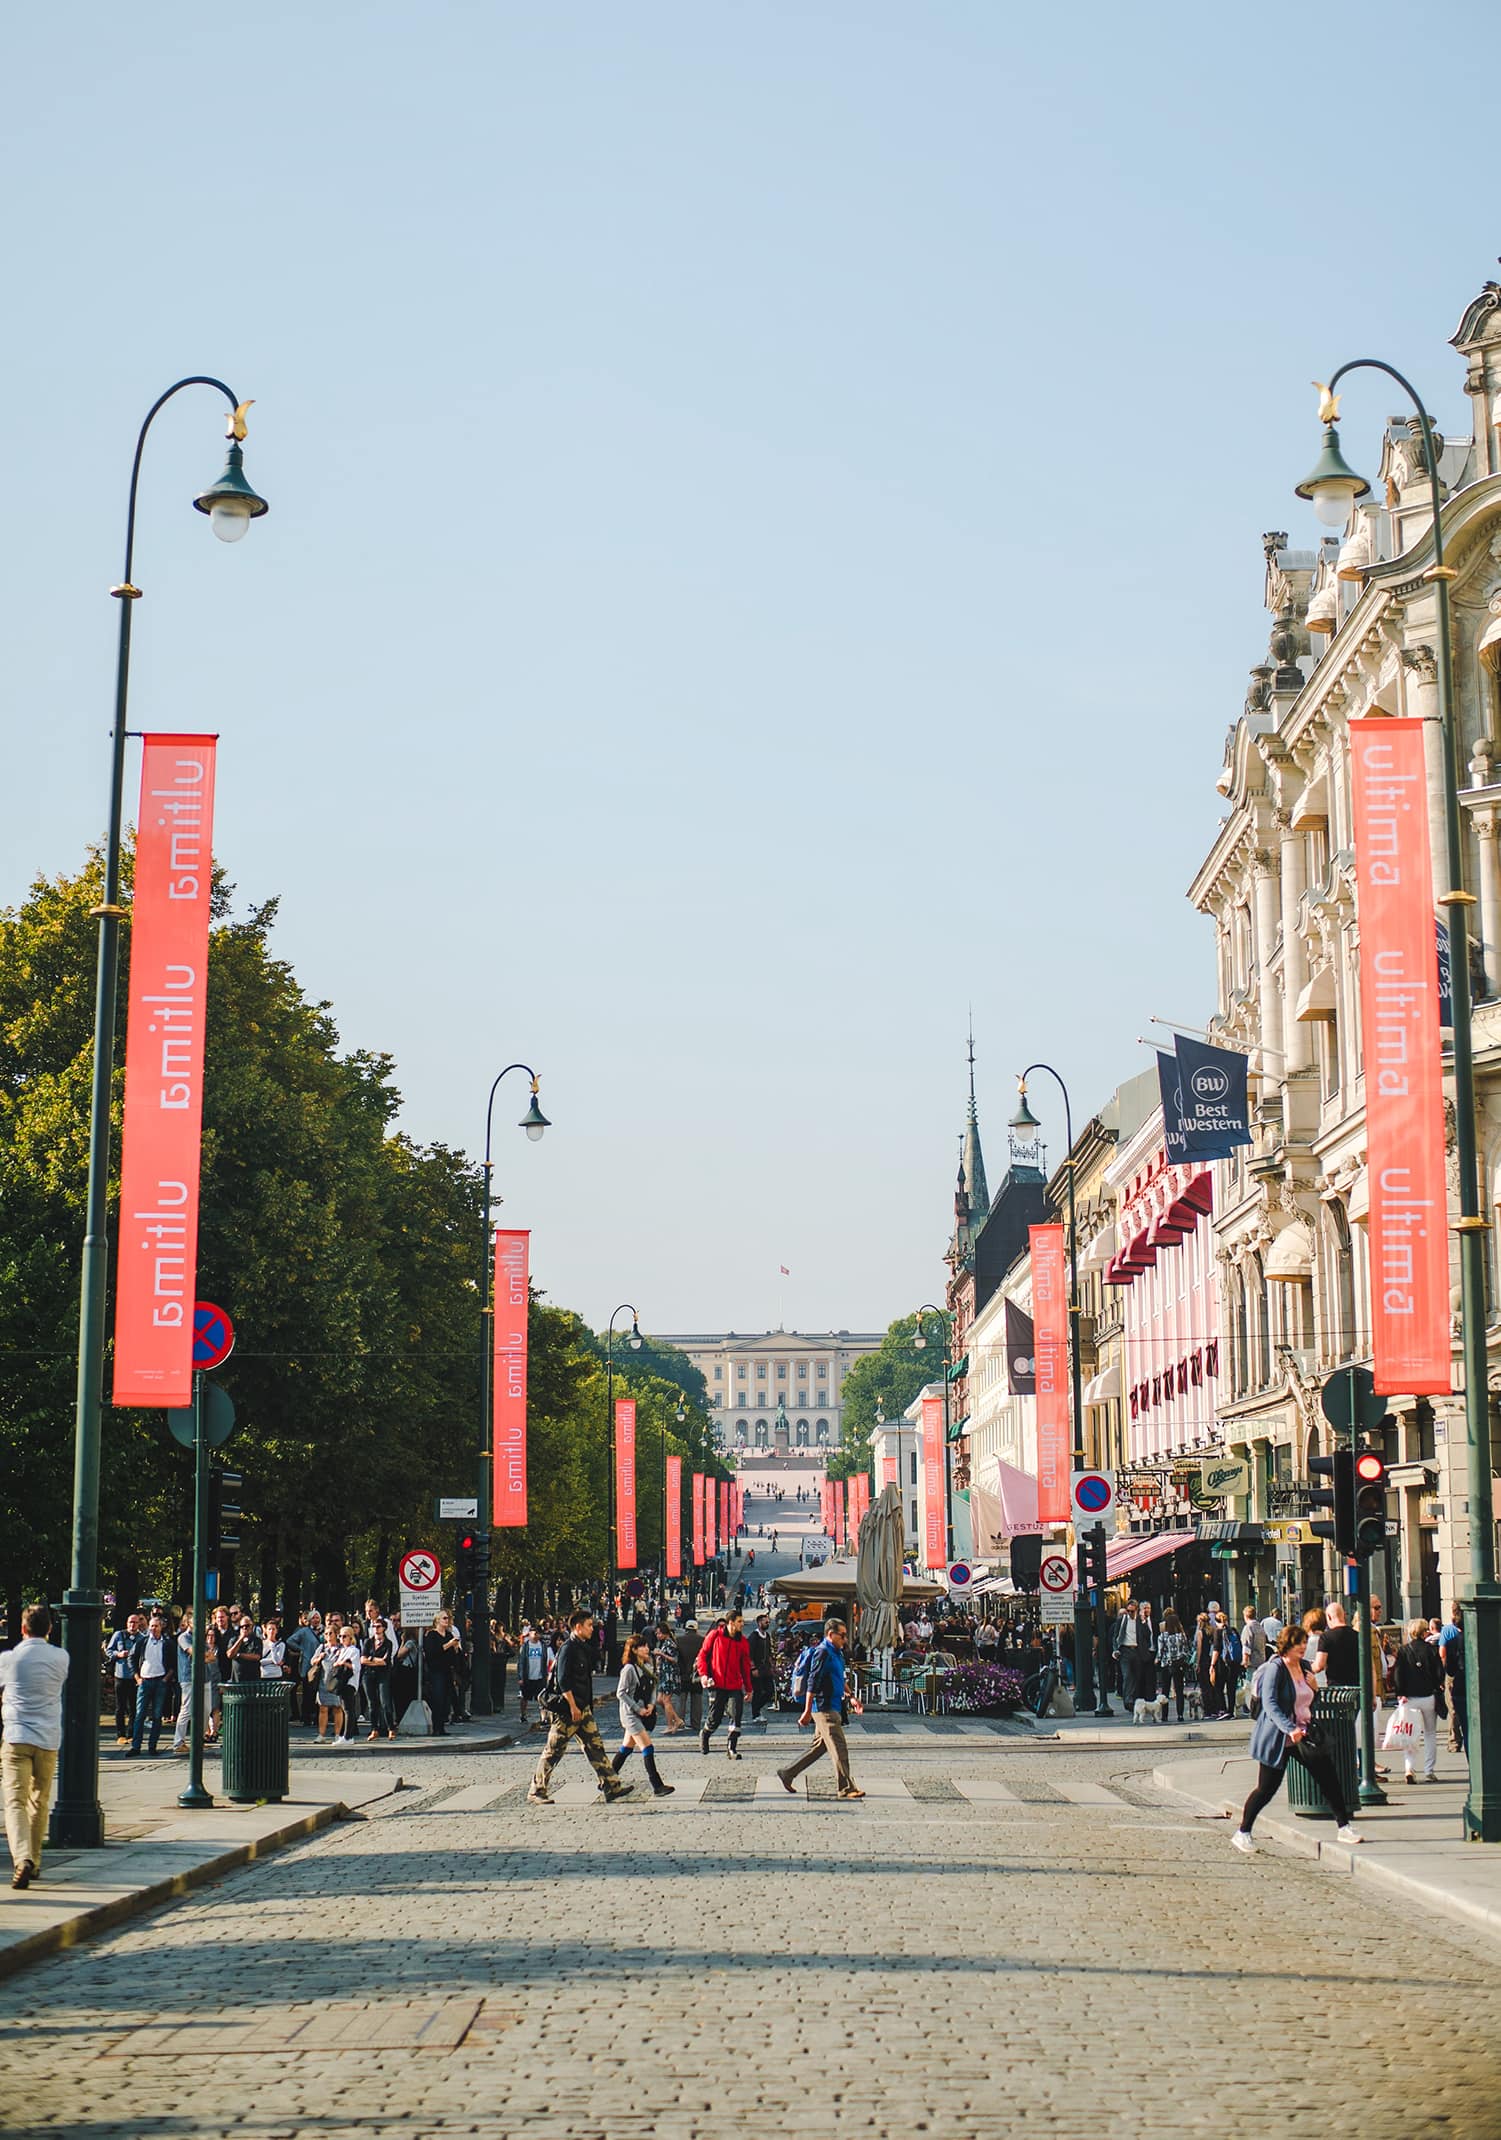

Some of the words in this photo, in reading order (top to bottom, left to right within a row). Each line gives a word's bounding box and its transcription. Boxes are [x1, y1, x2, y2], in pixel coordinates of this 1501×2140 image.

[1362, 743, 1418, 887] ultima
[1373, 949, 1428, 1097] ultima
[1195, 1104, 1229, 1117] Best
[1196, 1077, 1225, 1092] BW
[1184, 1118, 1243, 1132] Western
[1379, 1166, 1435, 1315] ultima
[1035, 1236, 1059, 1301] ultima
[1039, 1328, 1060, 1393] ultima
[925, 1405, 939, 1443] ultima
[926, 1457, 941, 1496] ultima
[1040, 1423, 1065, 1488] ultima
[927, 1511, 942, 1550] ultima
